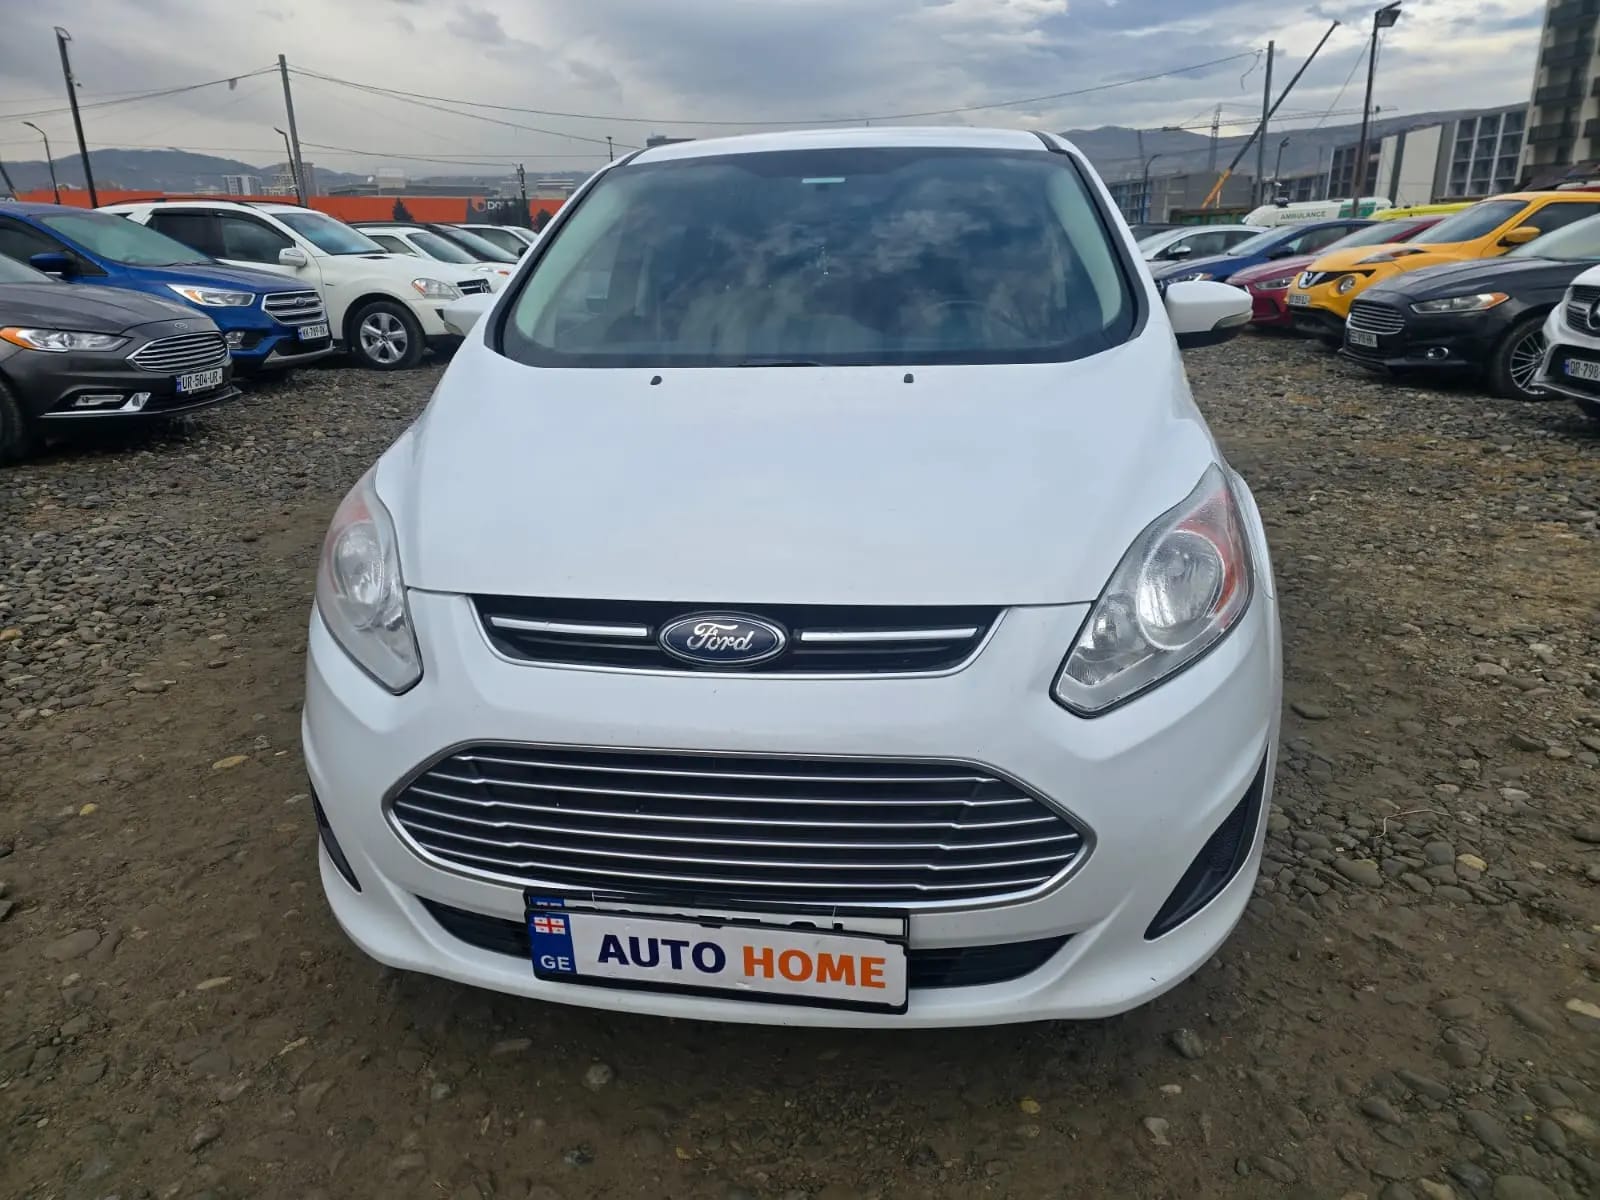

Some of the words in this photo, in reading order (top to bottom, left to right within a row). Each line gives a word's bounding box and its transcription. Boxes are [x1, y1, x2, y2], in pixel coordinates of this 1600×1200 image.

[1280, 211, 1327, 219] AMBULANCE
[686, 622, 755, 651] Ford
[540, 955, 572, 971] GE
[597, 934, 726, 974] AUTO
[743, 946, 886, 989] HOME
